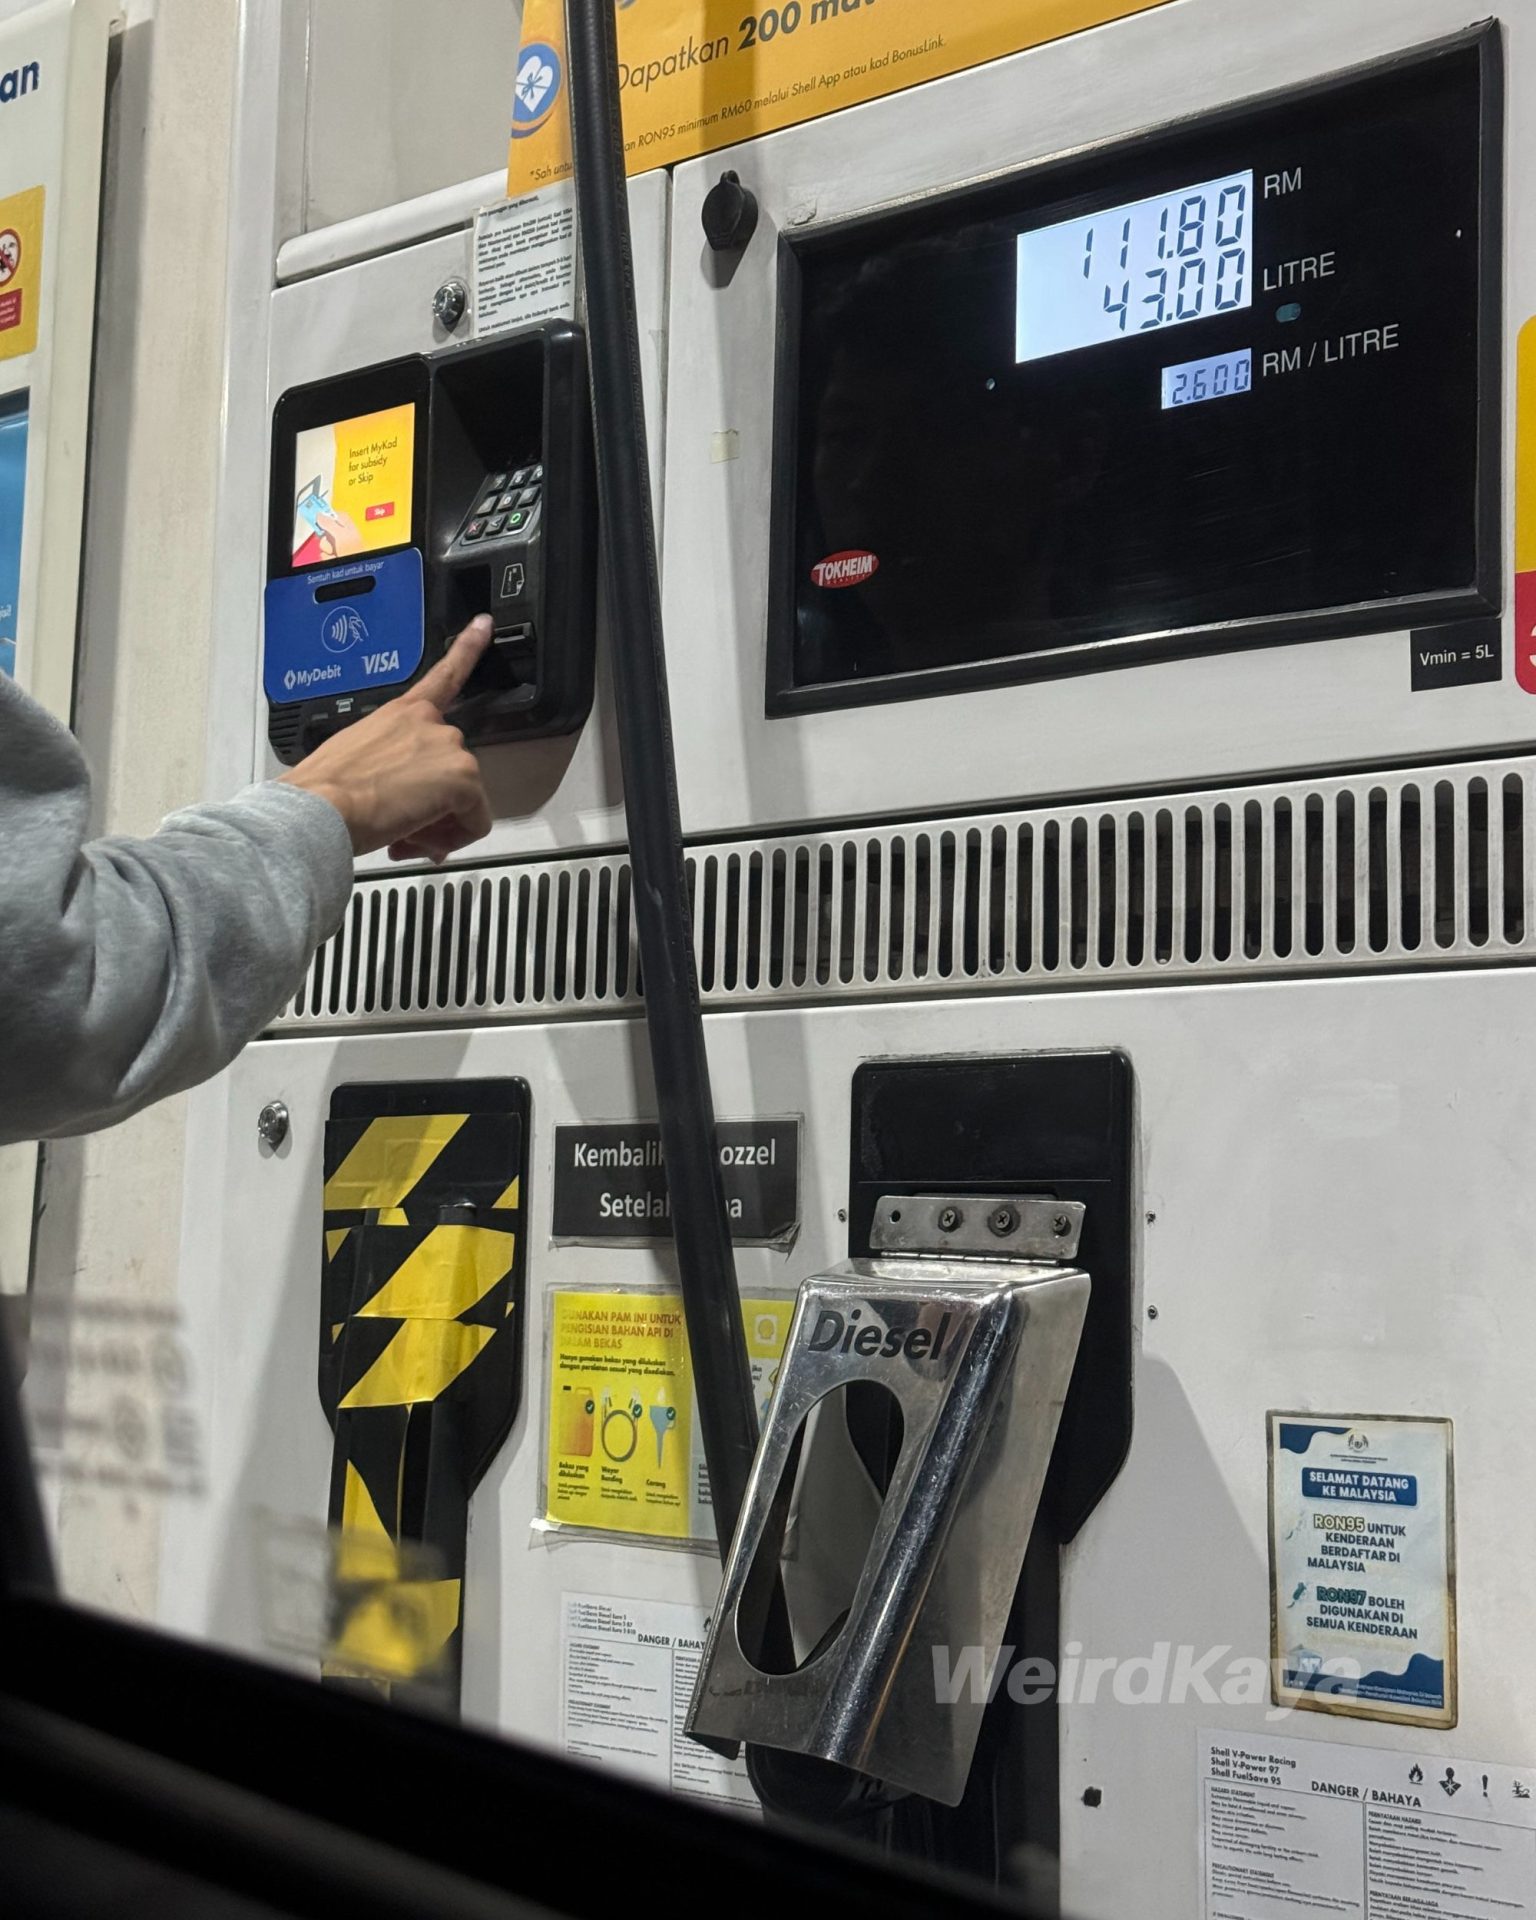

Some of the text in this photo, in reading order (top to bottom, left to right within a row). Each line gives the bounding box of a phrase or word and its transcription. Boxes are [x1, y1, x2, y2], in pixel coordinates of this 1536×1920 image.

[736, 1, 801, 52] 200
[638, 123, 675, 148] RON95
[677, 113, 719, 135] minimum
[721, 99, 752, 120] RM60
[753, 90, 789, 109] melalui
[791, 77, 816, 97] Shell
[818, 73, 840, 89] App
[843, 64, 867, 80] atau
[870, 53, 889, 70] kad
[892, 34, 946, 64] BonusLink.
[554, 162, 573, 176] untu
[1264, 167, 1302, 199] RM
[1082, 184, 1246, 279] 111.80
[1263, 252, 1335, 291] LITRE
[1103, 248, 1246, 331] 43.00
[1263, 323, 1399, 377] RM / LITRE
[1171, 359, 1250, 405] 2.600
[349, 437, 398, 459] Insert MyKad
[349, 455, 388, 472] for subsidy
[348, 472, 374, 486] or Skip
[307, 561, 384, 584] Sentuh kad untuk bayar
[813, 554, 873, 587] TOKHEIM
[361, 650, 399, 675] VISA
[1420, 644, 1494, 666] Vmin = 5L
[297, 664, 341, 687] MyDebit
[720, 1138, 776, 1166] ozzel
[610, 1311, 631, 1322] PAM
[650, 1313, 681, 1325] UNTUK
[594, 1338, 622, 1348] BEKAS
[611, 1325, 644, 1337] BAHAN
[647, 1327, 662, 1338] API
[664, 1328, 674, 1338] DI
[808, 1308, 953, 1360] Diesel
[1309, 1471, 1409, 1489] SELAMAT DATANG
[1322, 1485, 1397, 1502] KE MALAYSIA
[1313, 1513, 1406, 1537] RON95 UNTUK
[1325, 1532, 1395, 1549] KENDERAAN
[1307, 1557, 1366, 1573] MALAYSIA
[1321, 1545, 1401, 1563] BERDAFTAR DI
[1316, 1585, 1405, 1610] RON97 BOLEH
[1320, 1604, 1404, 1624] DIGUNAKAN DI
[1306, 1616, 1418, 1639] SEMUA KENDERAAN
[638, 1633, 670, 1646] DANGER
[678, 1638, 705, 1650] BAHAY
[1211, 1746, 1296, 1769] Shell V-Power Racing
[1211, 1757, 1280, 1775] Shell V-Power 97
[1211, 1767, 1281, 1785] Shell FuelSave 95
[1311, 1780, 1421, 1808] DANGER / BAHAYA
